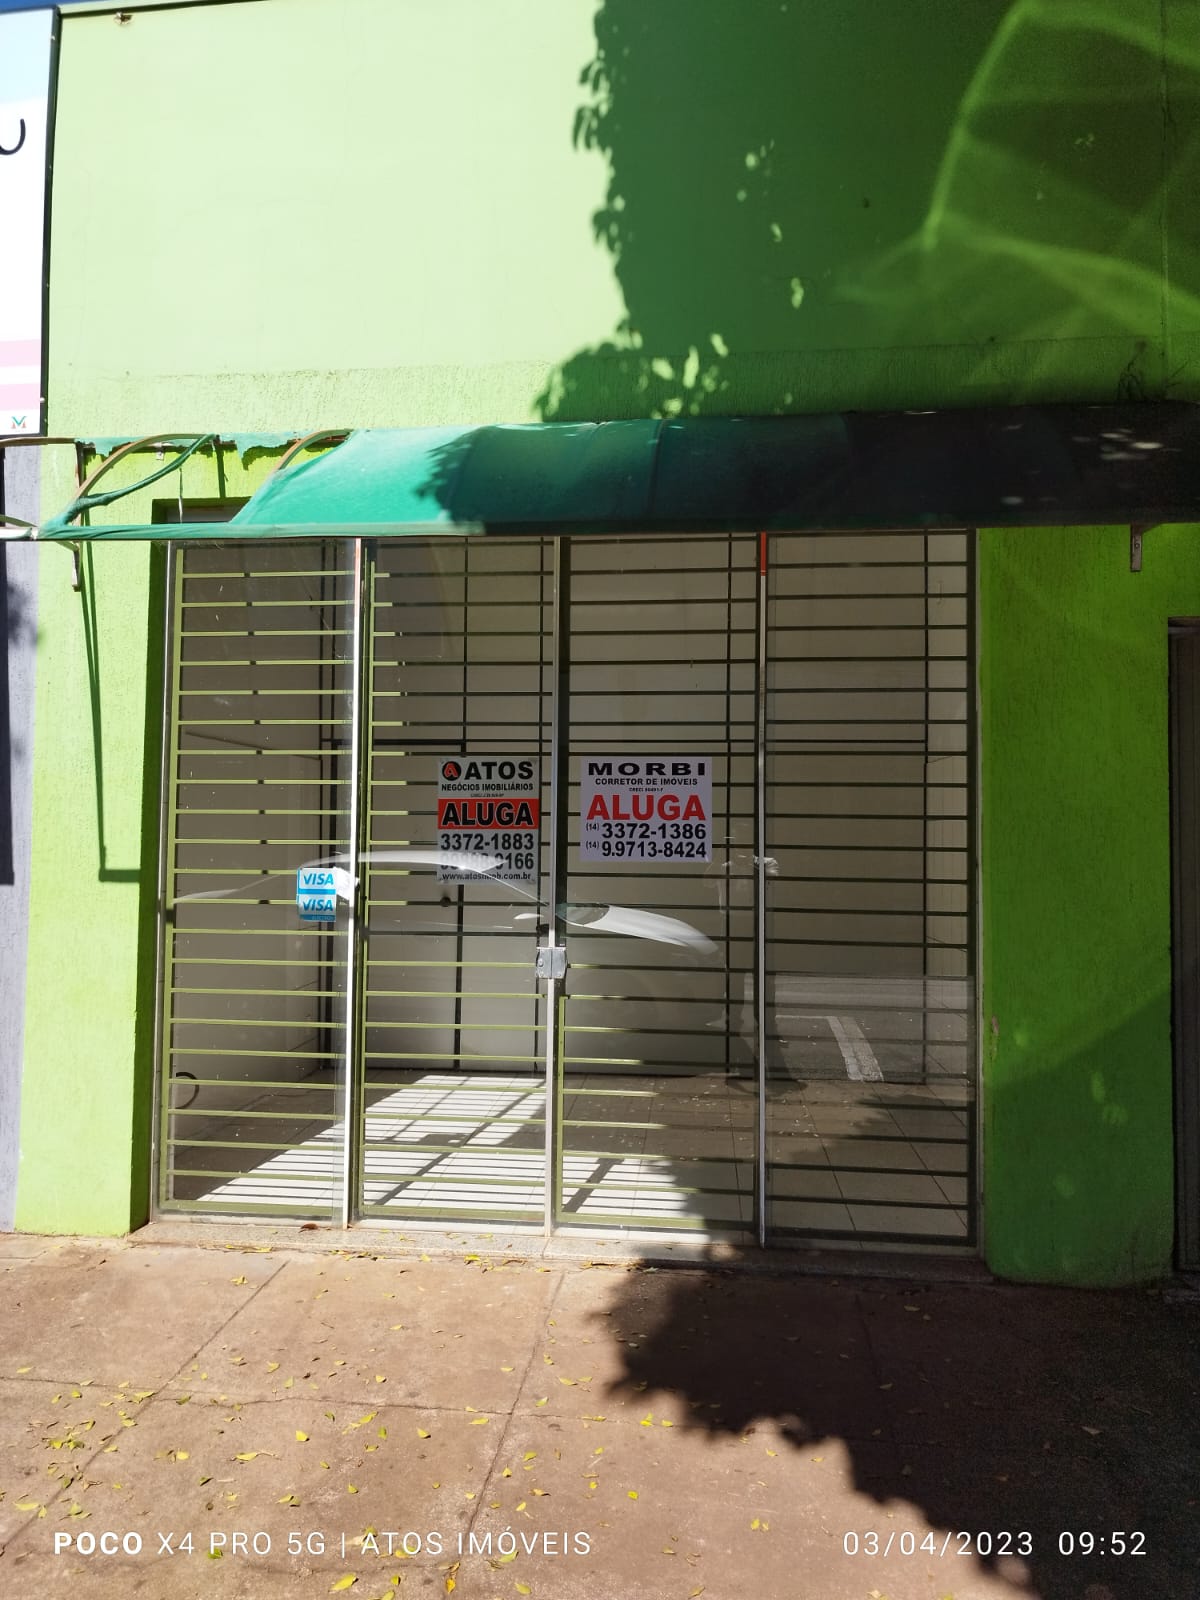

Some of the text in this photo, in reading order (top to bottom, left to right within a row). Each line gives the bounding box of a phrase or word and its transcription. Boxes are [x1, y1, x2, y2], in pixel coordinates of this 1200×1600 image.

[464, 761, 534, 780] ATOS
[588, 762, 705, 776] MORBI
[441, 783, 534, 791] NEGÓCIOS IMOBILIÁRIOS
[595, 777, 698, 786] CORRETOR DE IMÓVEIS
[442, 801, 535, 827] ALUGA
[586, 794, 706, 821] ALUGA
[586, 822, 706, 839] (14) 3372-1386
[440, 833, 534, 850] 3372-1883
[585, 841, 706, 858] (14) 9.9713-8424
[303, 873, 334, 885] VISA
[302, 899, 334, 911] VISA
